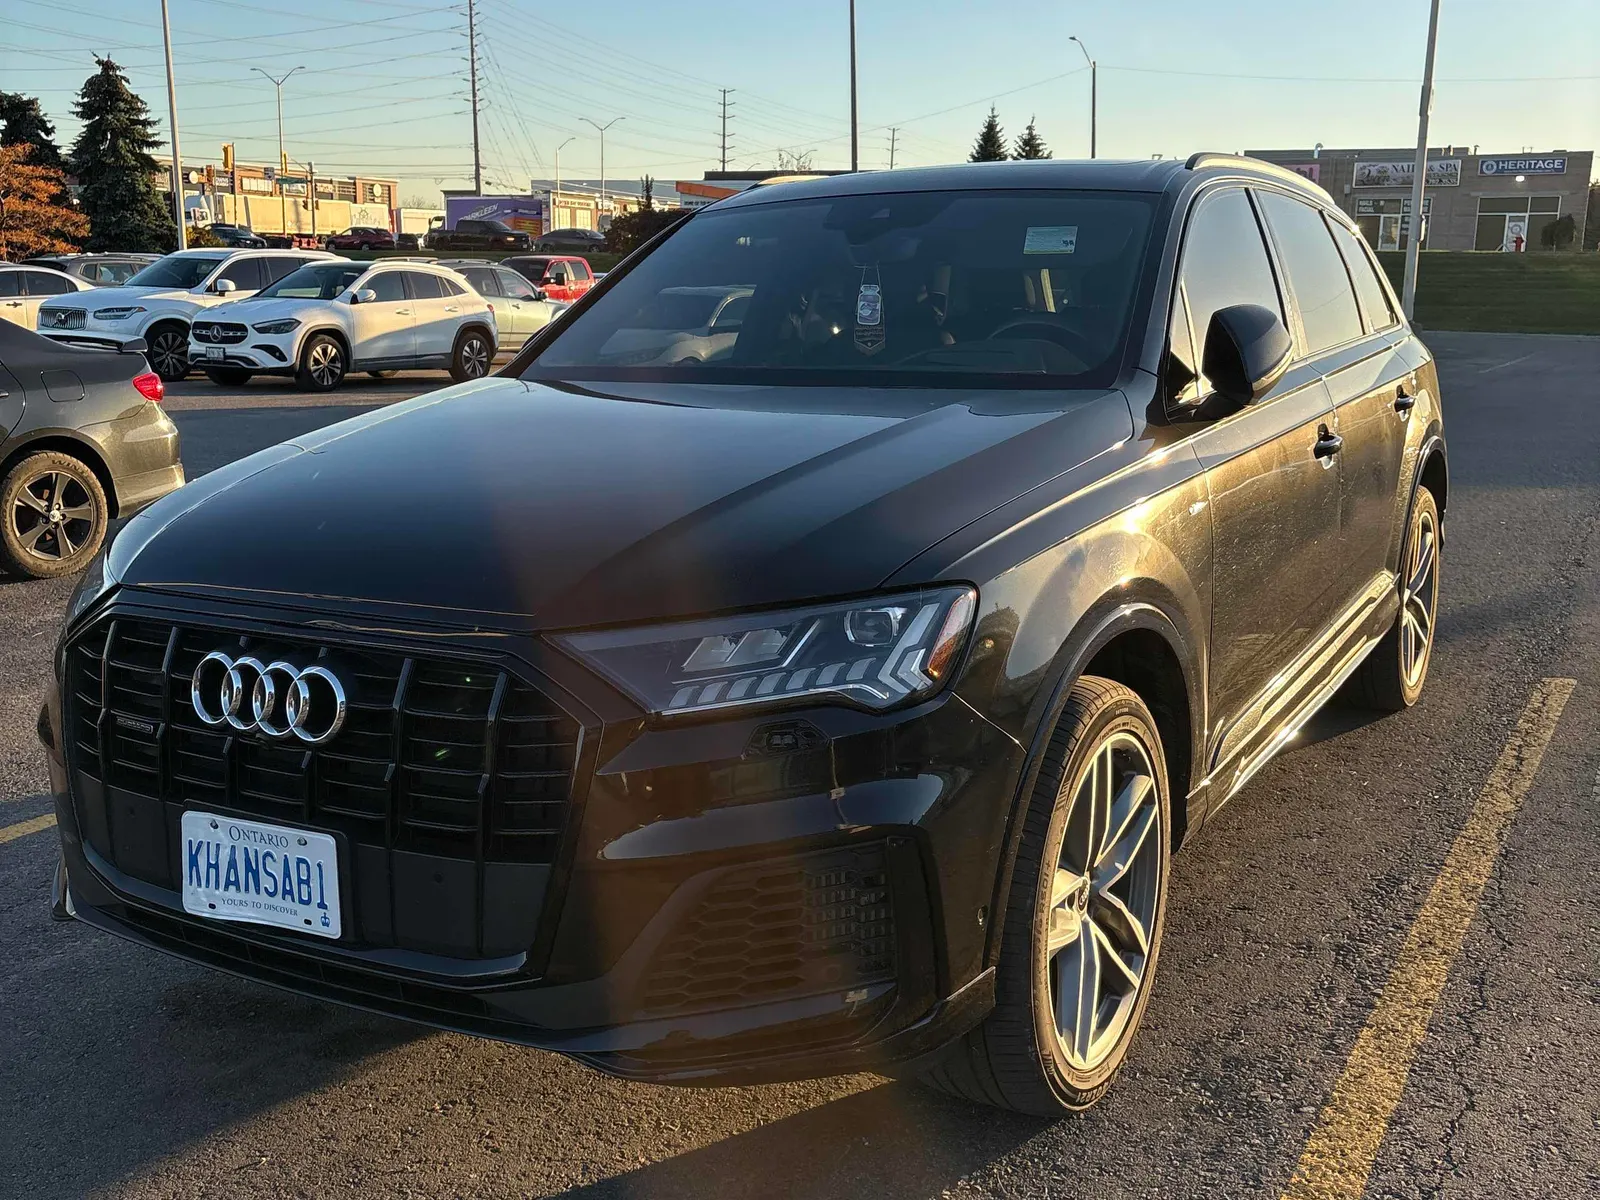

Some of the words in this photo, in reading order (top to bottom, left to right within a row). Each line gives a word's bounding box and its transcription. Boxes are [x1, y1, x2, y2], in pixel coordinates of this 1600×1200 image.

[1439, 163, 1458, 172] SPA
[1498, 159, 1563, 170] HERITAGE
[187, 838, 329, 911] KHANSAB1
[221, 897, 249, 908] YOURS
[251, 901, 263, 909] TO
[263, 902, 299, 917] DISCOVER
